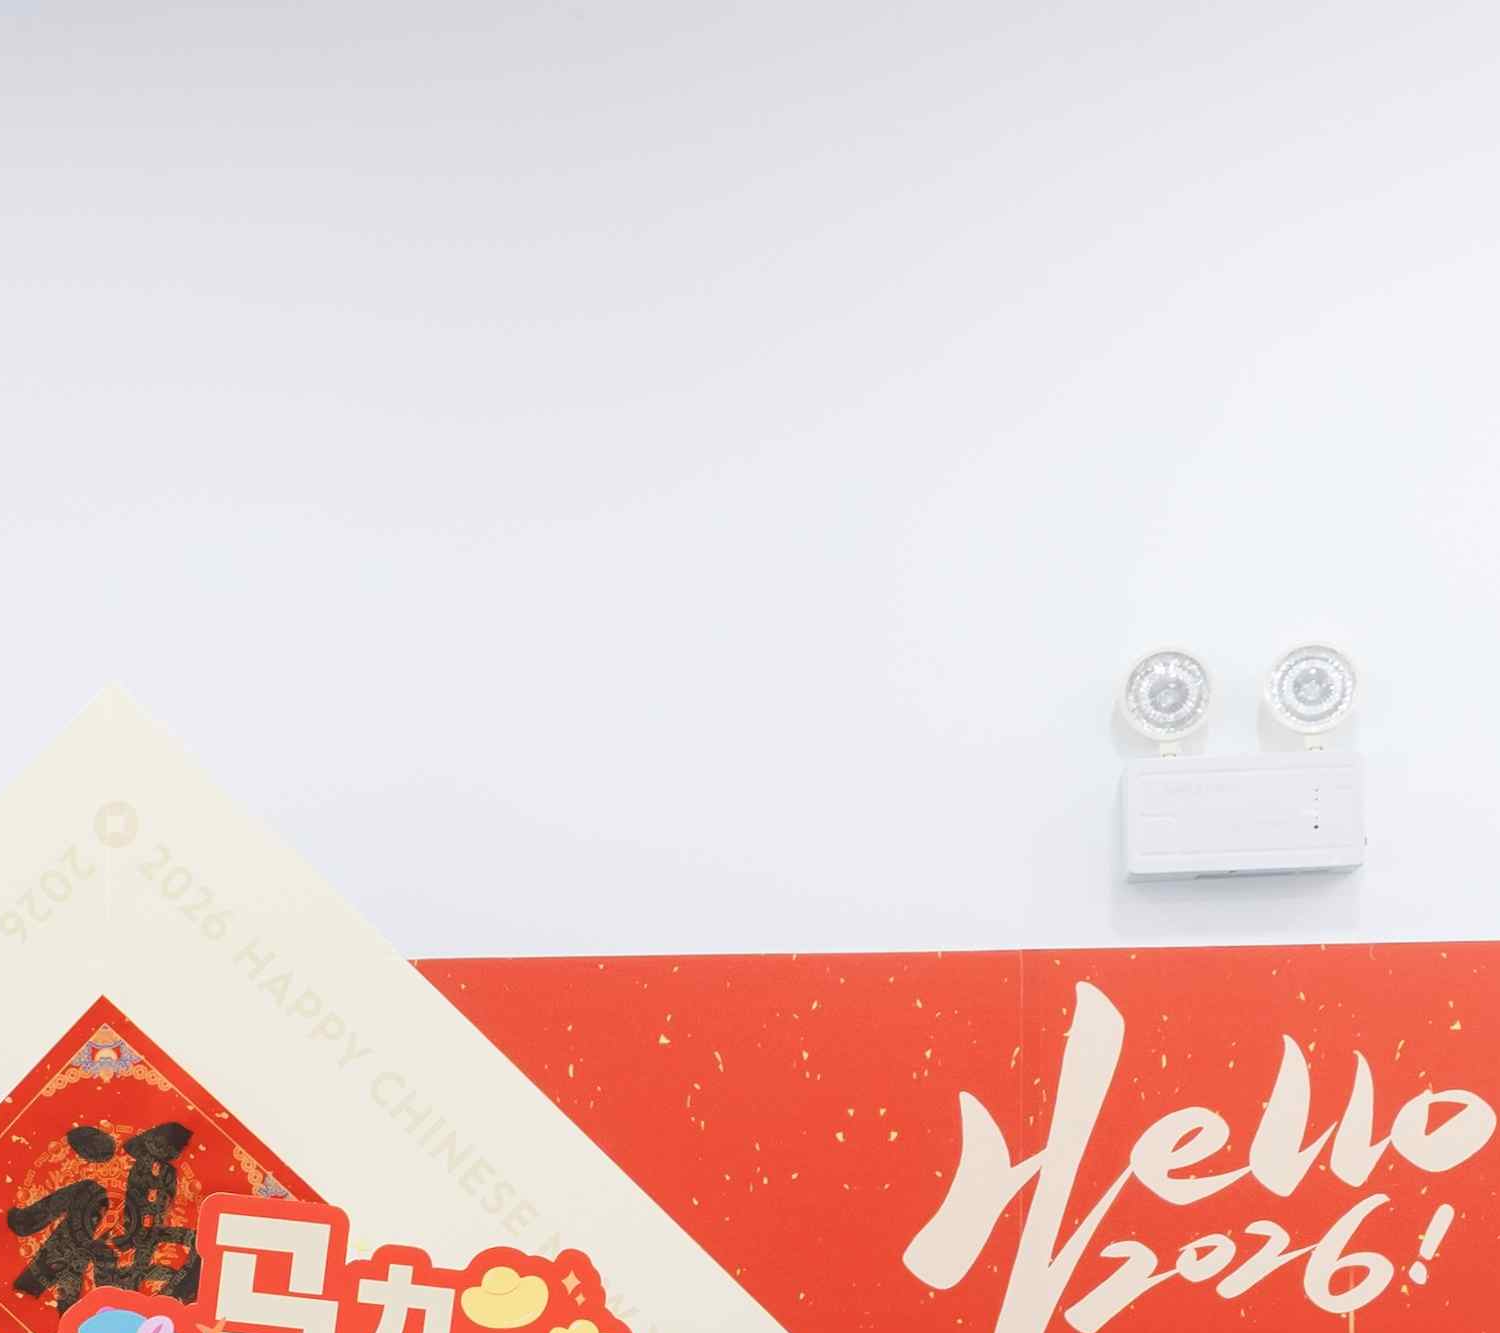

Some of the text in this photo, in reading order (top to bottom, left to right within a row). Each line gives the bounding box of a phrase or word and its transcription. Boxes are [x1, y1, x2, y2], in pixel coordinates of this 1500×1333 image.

[135, 841, 239, 946] 2026
[231, 933, 377, 1074] HAPPY
[369, 1069, 540, 1239] CHINESE
